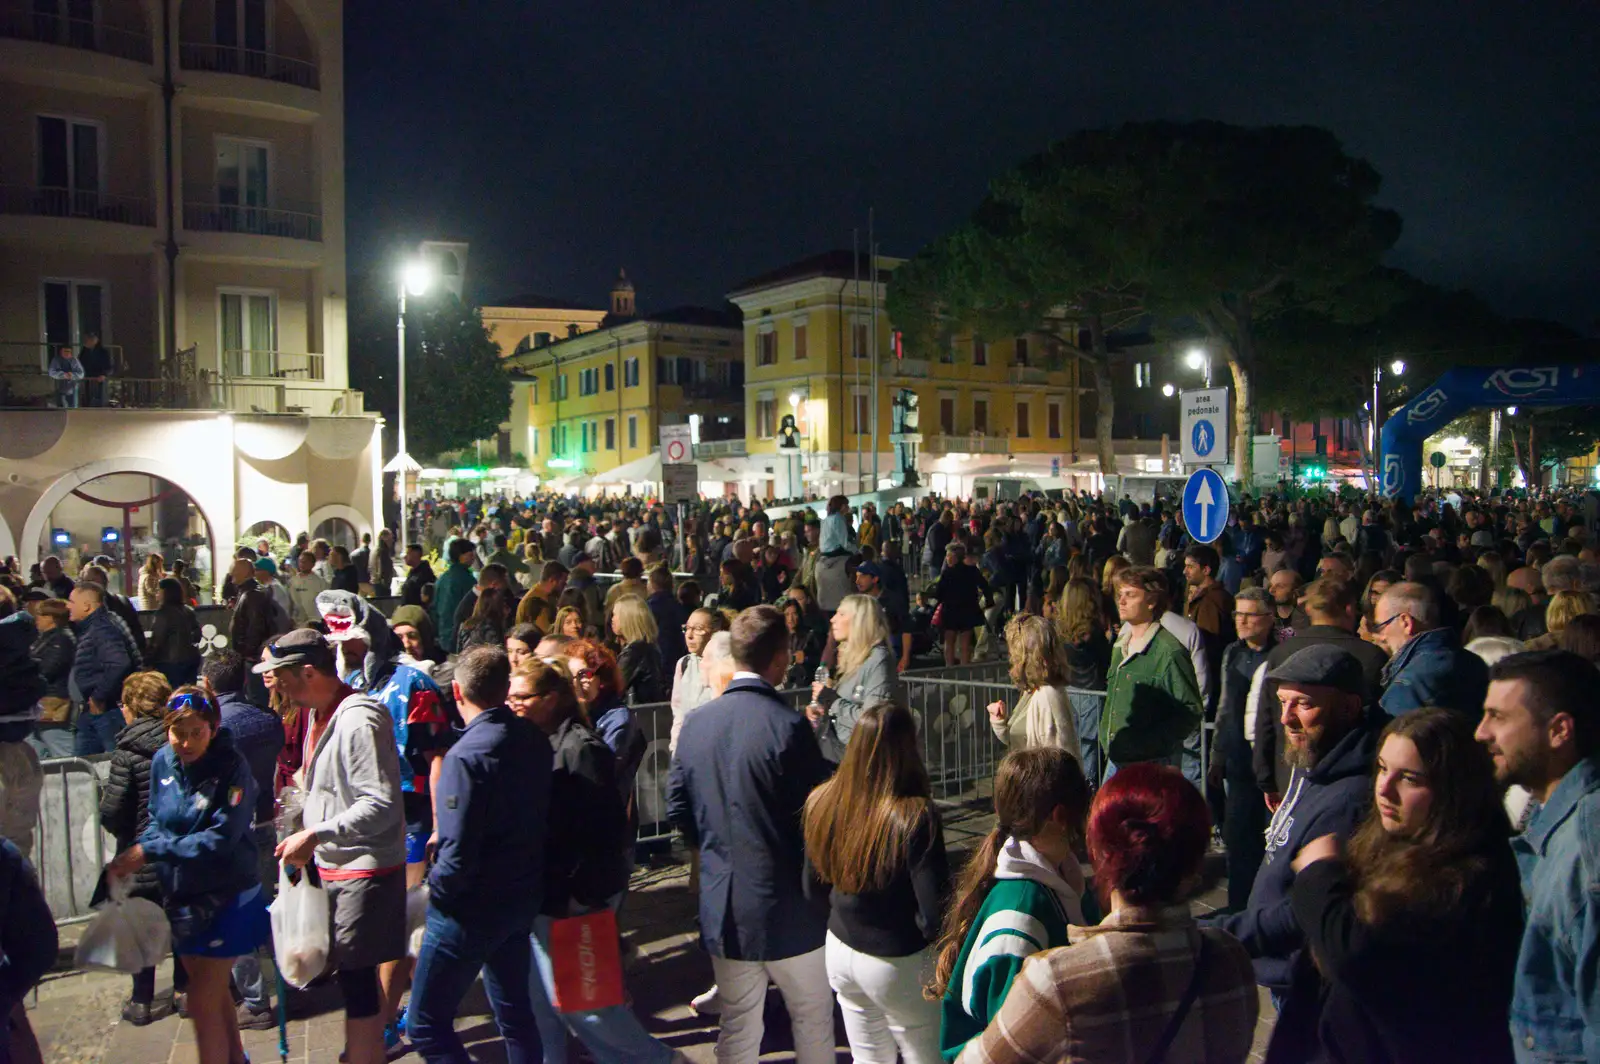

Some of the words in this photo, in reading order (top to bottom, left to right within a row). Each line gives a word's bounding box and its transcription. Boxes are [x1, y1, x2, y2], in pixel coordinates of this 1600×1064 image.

[1483, 367, 1558, 389] ACSI
[1195, 395, 1211, 403] area
[1188, 405, 1219, 417] pedonale
